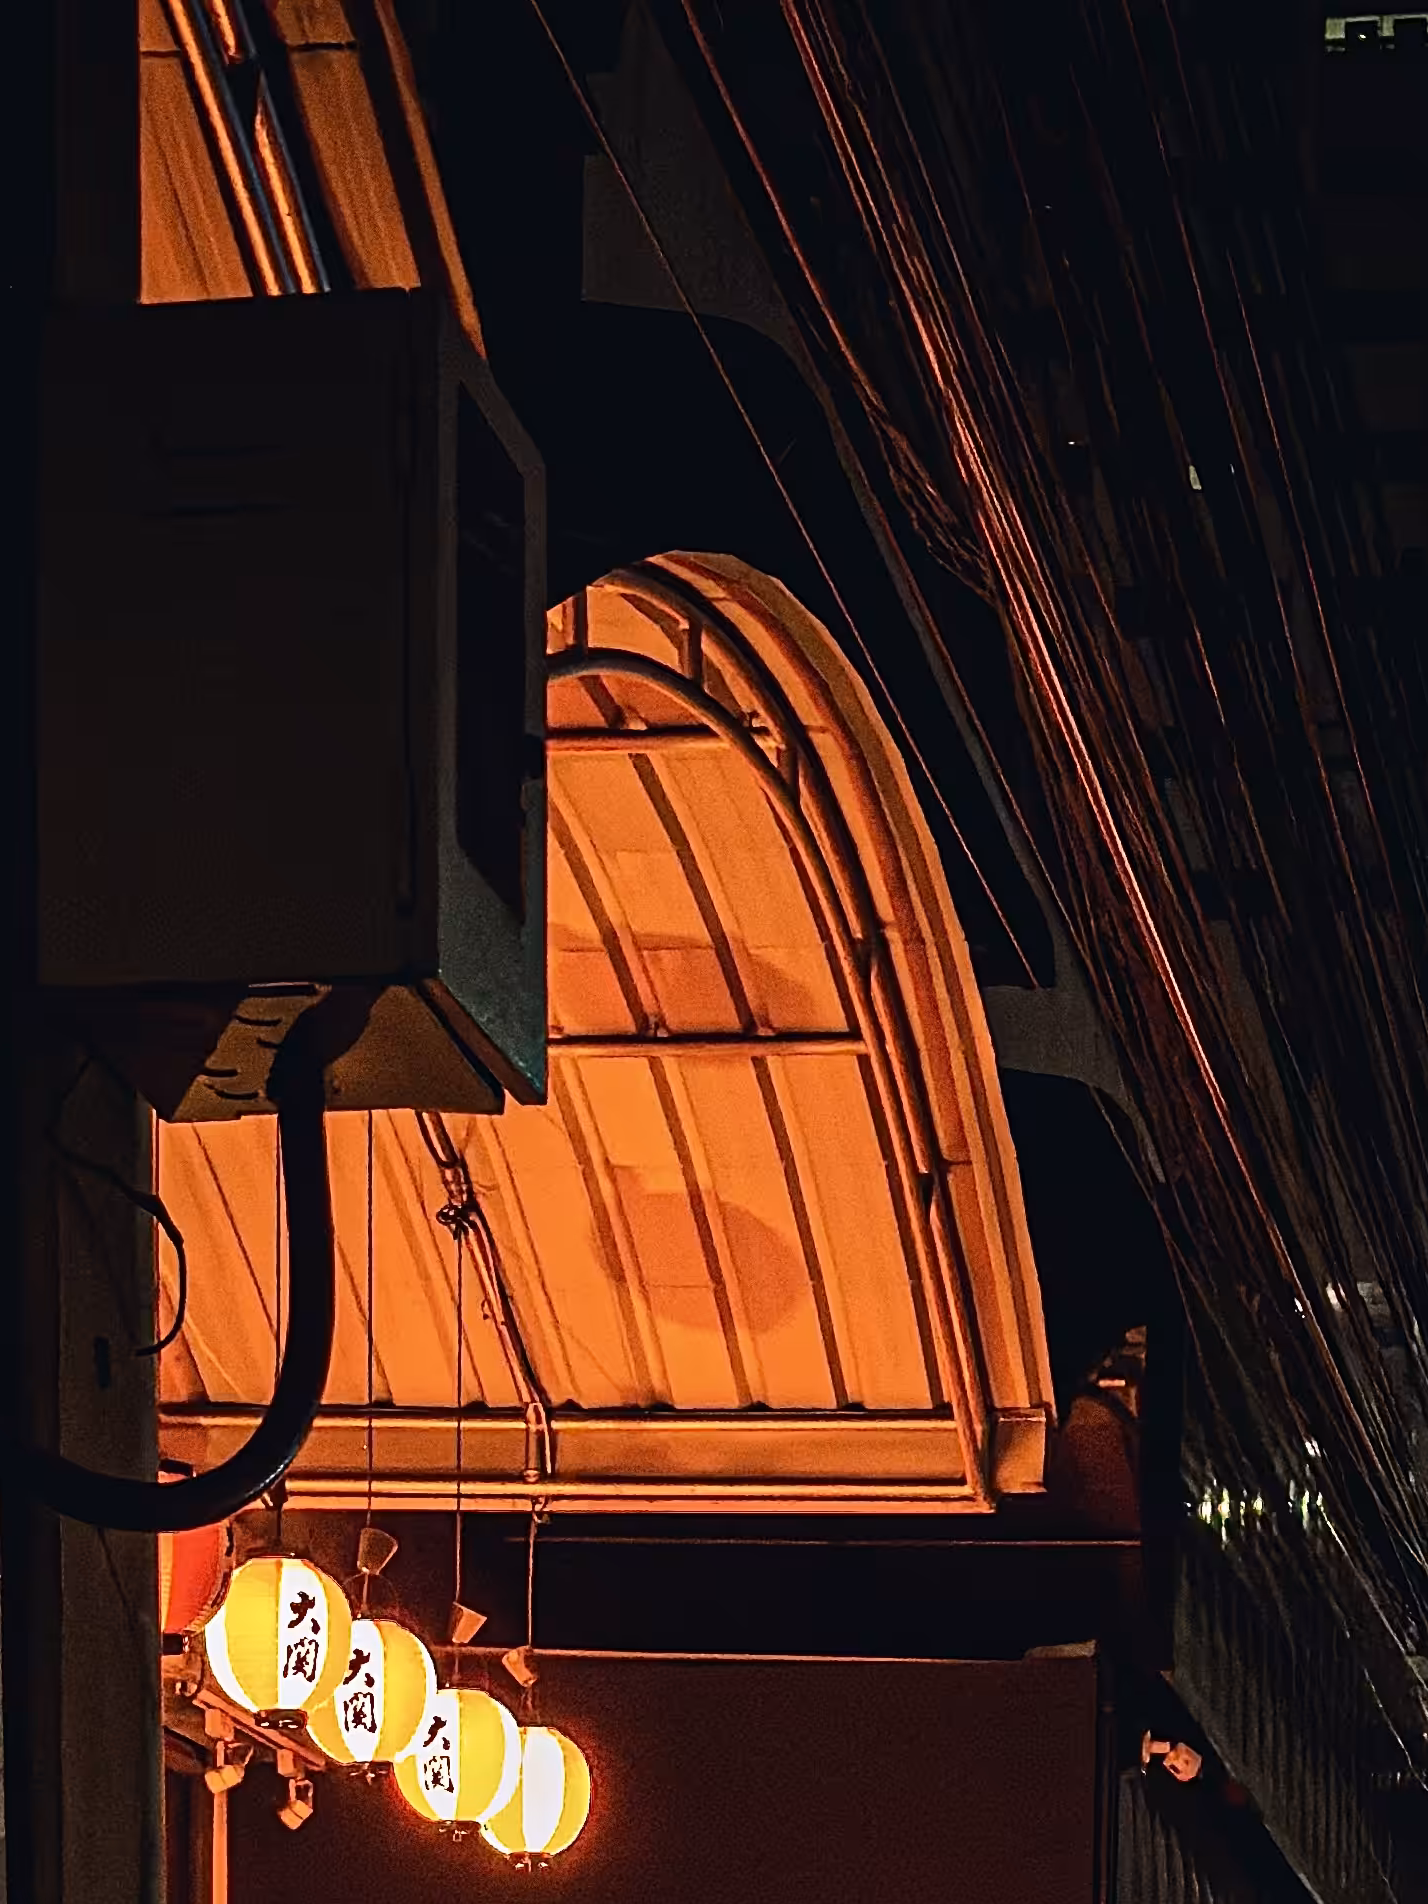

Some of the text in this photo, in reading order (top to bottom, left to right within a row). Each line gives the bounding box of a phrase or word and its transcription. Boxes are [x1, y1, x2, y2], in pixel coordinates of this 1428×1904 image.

[283, 1591, 320, 1682] 大関
[343, 1649, 377, 1733] 大関
[423, 1716, 454, 1793] 大関
